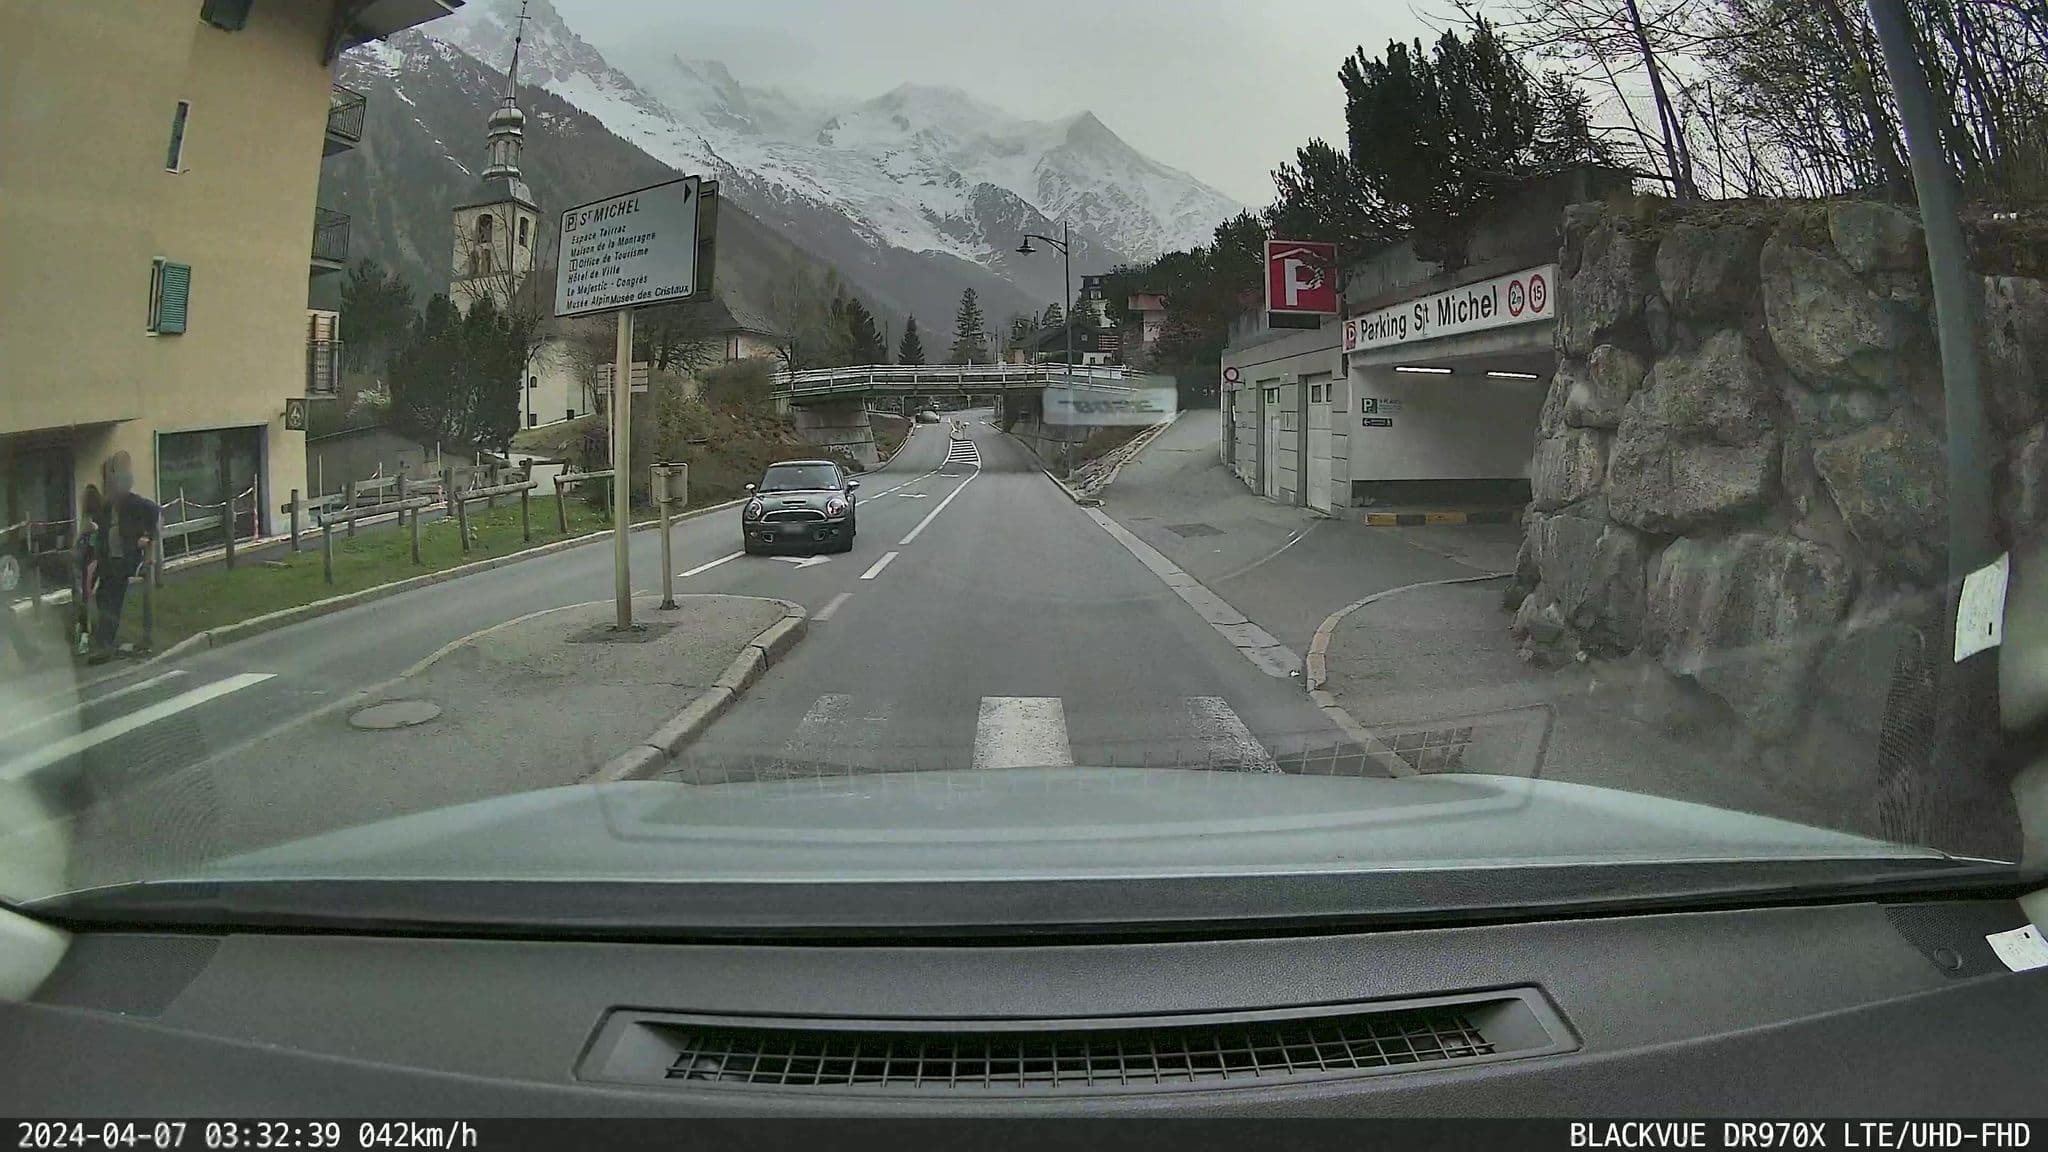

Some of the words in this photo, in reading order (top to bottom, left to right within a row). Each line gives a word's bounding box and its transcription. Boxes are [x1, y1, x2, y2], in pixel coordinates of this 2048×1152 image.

[594, 197, 640, 223] MICHEL
[571, 232, 597, 245] Espace
[571, 246, 595, 257] Maison
[597, 242, 606, 251] de
[608, 239, 615, 248] la
[617, 231, 656, 247] Montagne
[579, 257, 600, 269] Office
[602, 253, 611, 263] de
[615, 247, 649, 261] Tourisme
[568, 270, 588, 284] Hôtel
[590, 269, 599, 279] de
[602, 265, 620, 276] Ville
[567, 287, 574, 297] Le
[577, 280, 607, 295] Majestic
[591, 294, 610, 306] Alpin
[638, 289, 652, 300] des
[655, 285, 689, 297] Cristaux
[1360, 313, 1407, 341] Parking
[1414, 303, 1430, 331] St
[1438, 285, 1498, 327] Michel
[1533, 285, 1543, 302] 15
